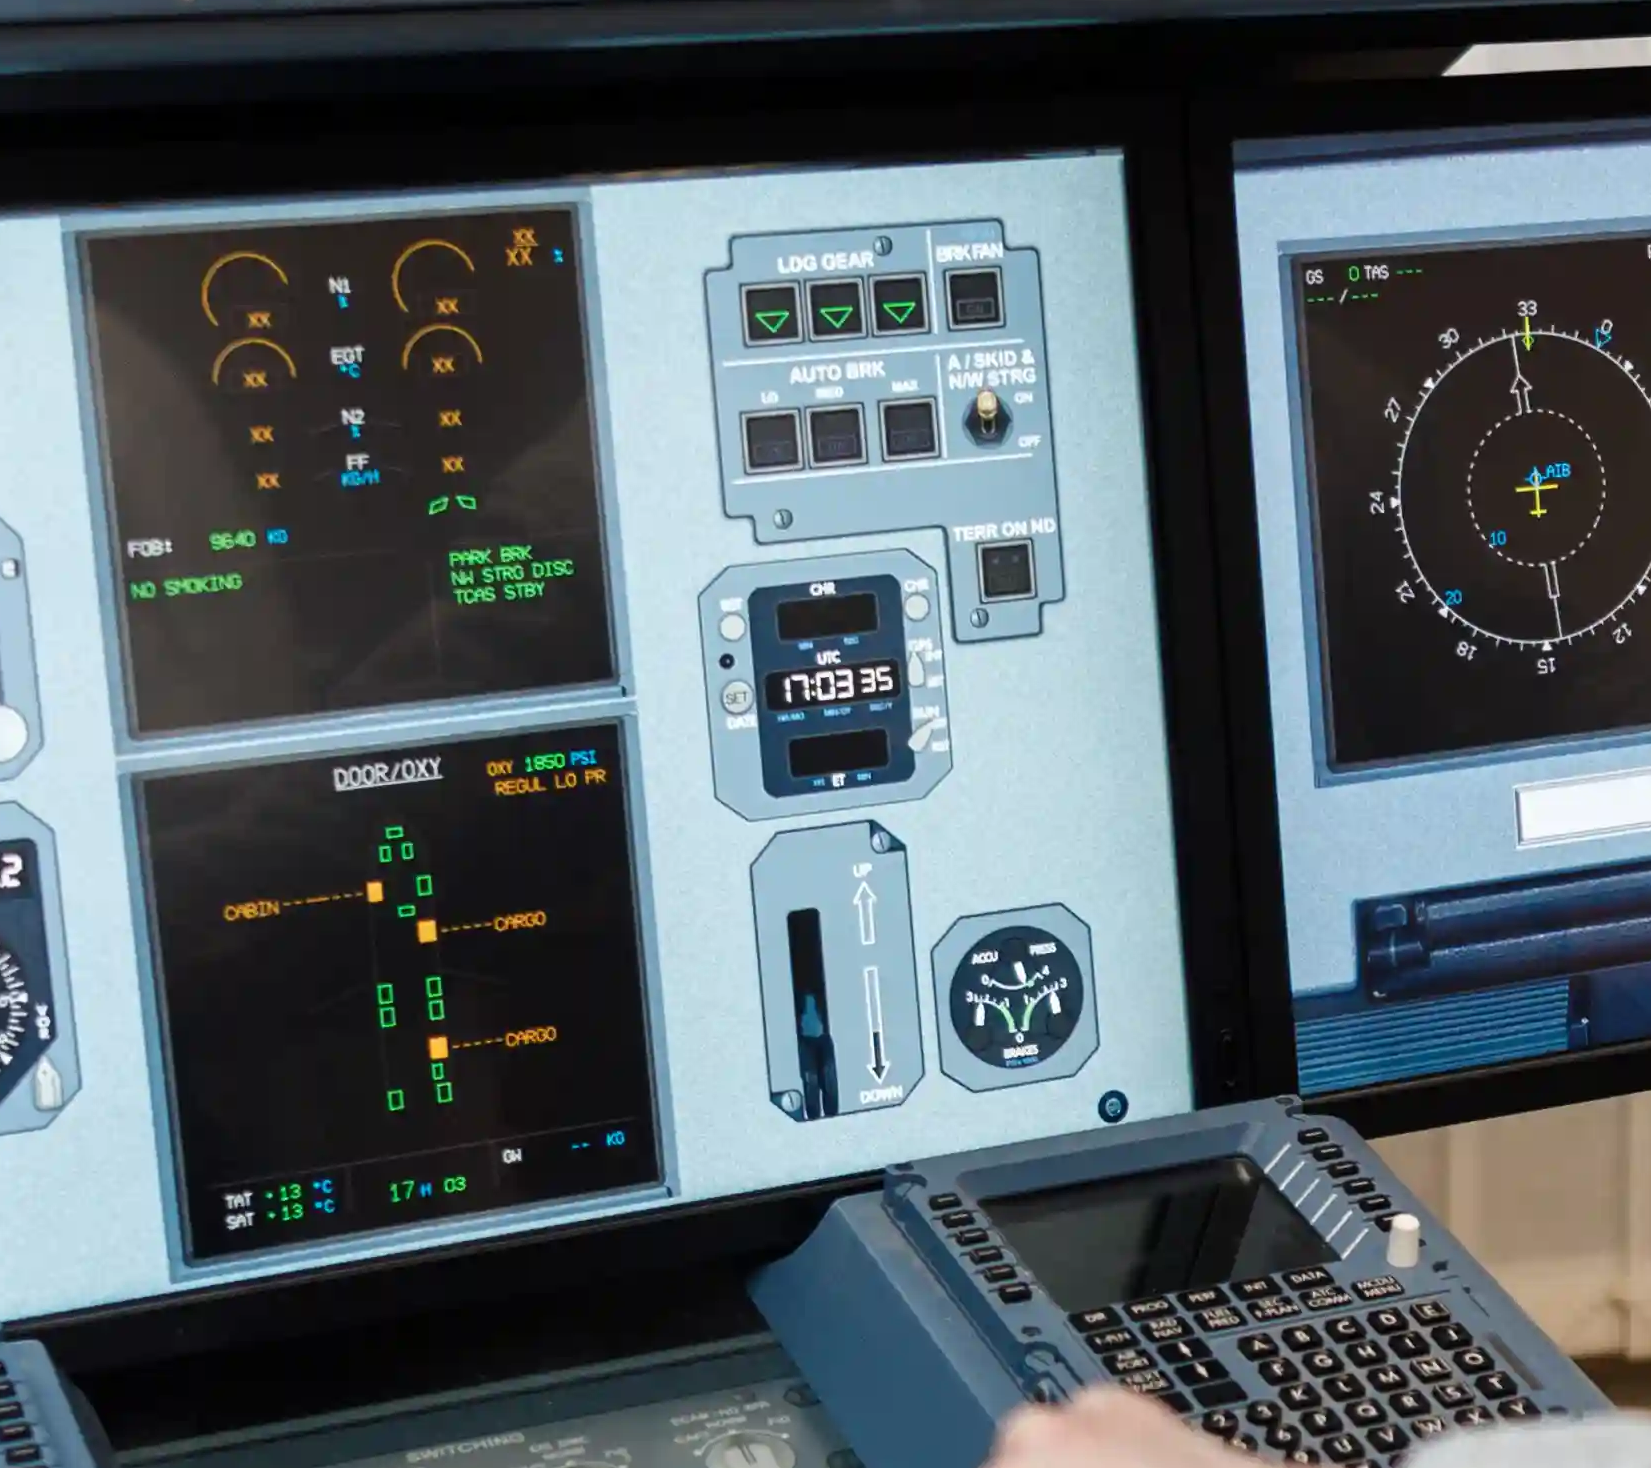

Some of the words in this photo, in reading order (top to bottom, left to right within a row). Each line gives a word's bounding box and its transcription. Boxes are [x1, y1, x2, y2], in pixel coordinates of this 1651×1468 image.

[936, 245, 972, 263] BRK
[972, 242, 1004, 260] FAN
[777, 255, 817, 274] LDG
[821, 250, 874, 270] GEAR
[1305, 269, 1324, 284] GS
[1348, 265, 1360, 282] 0
[1364, 264, 1390, 281] TAS
[329, 277, 352, 294] N1
[436, 297, 459, 314] XX
[1517, 300, 1537, 317] 33
[248, 312, 271, 328] XX
[1437, 327, 1460, 350] 30
[331, 346, 365, 365] EGT
[432, 356, 455, 373] XX
[243, 371, 267, 388] XX
[790, 364, 841, 384] AUTO
[846, 361, 885, 379] BRK
[987, 367, 1037, 386] STRG
[1014, 391, 1033, 404] ON
[341, 409, 365, 425] N2
[439, 410, 462, 427] XX
[1384, 397, 1403, 422] 27
[250, 426, 274, 443] XX
[1017, 435, 1041, 449] OFF
[346, 454, 369, 470] FF
[442, 456, 465, 472] XX
[1546, 462, 1571, 478] AIB
[256, 473, 281, 489] XX
[1369, 491, 1386, 514] 24
[952, 523, 999, 542] TERR
[1001, 520, 1029, 538] ON
[1030, 518, 1056, 536] ND
[1489, 530, 1507, 546] 10
[449, 548, 491, 566] PARK
[500, 545, 533, 563] BRK
[452, 570, 478, 586] NW
[483, 565, 525, 584] STRG
[532, 559, 574, 578] DISC
[131, 582, 158, 599] NO
[164, 573, 242, 596] SMOKING
[453, 586, 497, 604] TCAS
[504, 582, 546, 600] STBY
[1444, 589, 1463, 606] 20
[816, 650, 841, 665] UTC
[1456, 640, 1479, 661] 18
[1535, 656, 1557, 674] 15
[782, 669, 855, 703] 17:03
[860, 666, 894, 693] 35
[726, 691, 749, 705] SET
[487, 760, 513, 777] OXY
[525, 752, 566, 772] 1850
[570, 750, 596, 766] PSI
[333, 756, 444, 790] DOOR/OXY
[494, 777, 546, 795] REGUL
[554, 772, 577, 789] LO
[584, 769, 607, 785] PR
[853, 864, 872, 879] UP
[223, 899, 280, 921] CABIN
[494, 910, 546, 930] CARGO
[1029, 942, 1057, 957] PRESS
[505, 1027, 557, 1047] CARGO
[859, 1086, 903, 1104] DOWN
[389, 1181, 415, 1202] 17
[443, 1176, 467, 1194] 03
[1132, 1301, 1169, 1314] PROG
[1188, 1291, 1216, 1303] PERF
[1291, 1270, 1325, 1283] DATA
[1365, 1286, 1402, 1298] MENU
[1309, 1296, 1352, 1308] COMM
[405, 1433, 525, 1463] SWITCHING
